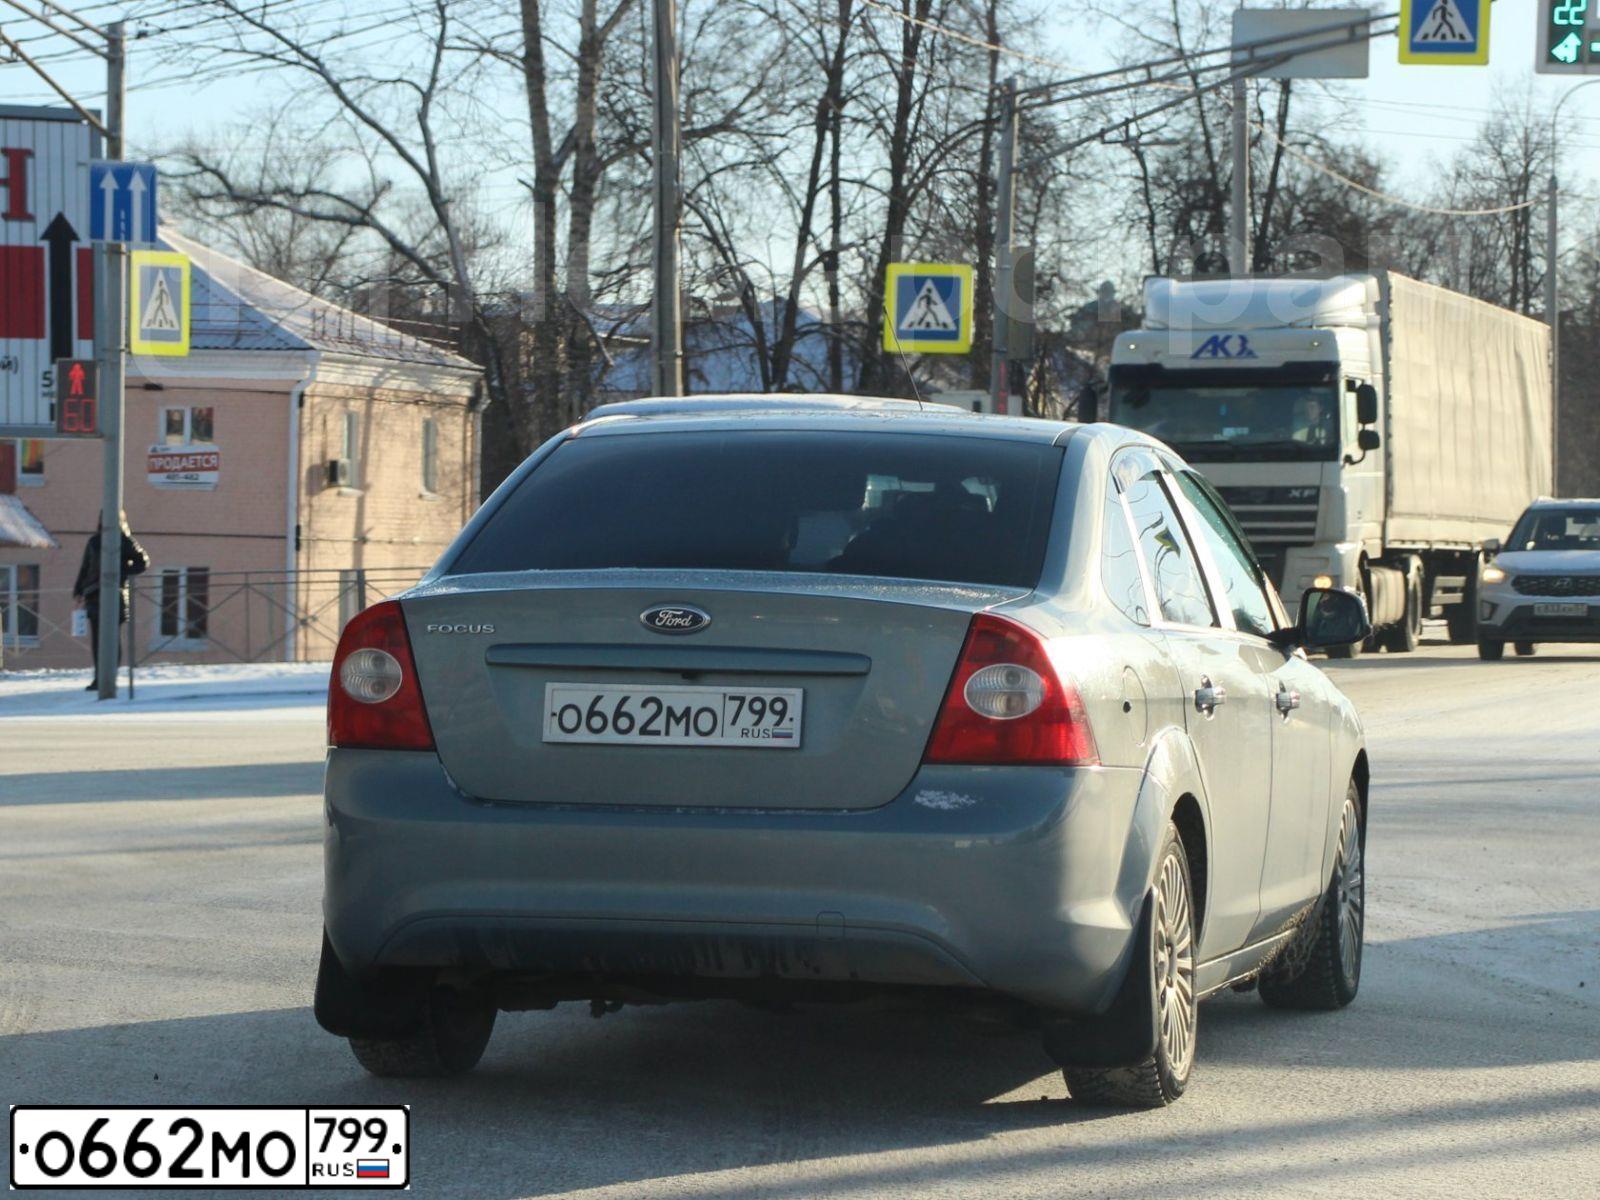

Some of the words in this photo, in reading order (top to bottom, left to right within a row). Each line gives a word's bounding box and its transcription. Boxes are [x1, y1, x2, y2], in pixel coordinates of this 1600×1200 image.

[149, 454, 218, 471] ПРОДАЕТСЯ
[654, 609, 692, 628] Ford
[427, 623, 495, 634] FOCUS
[728, 695, 789, 727] 799
[741, 727, 771, 739] RUS
